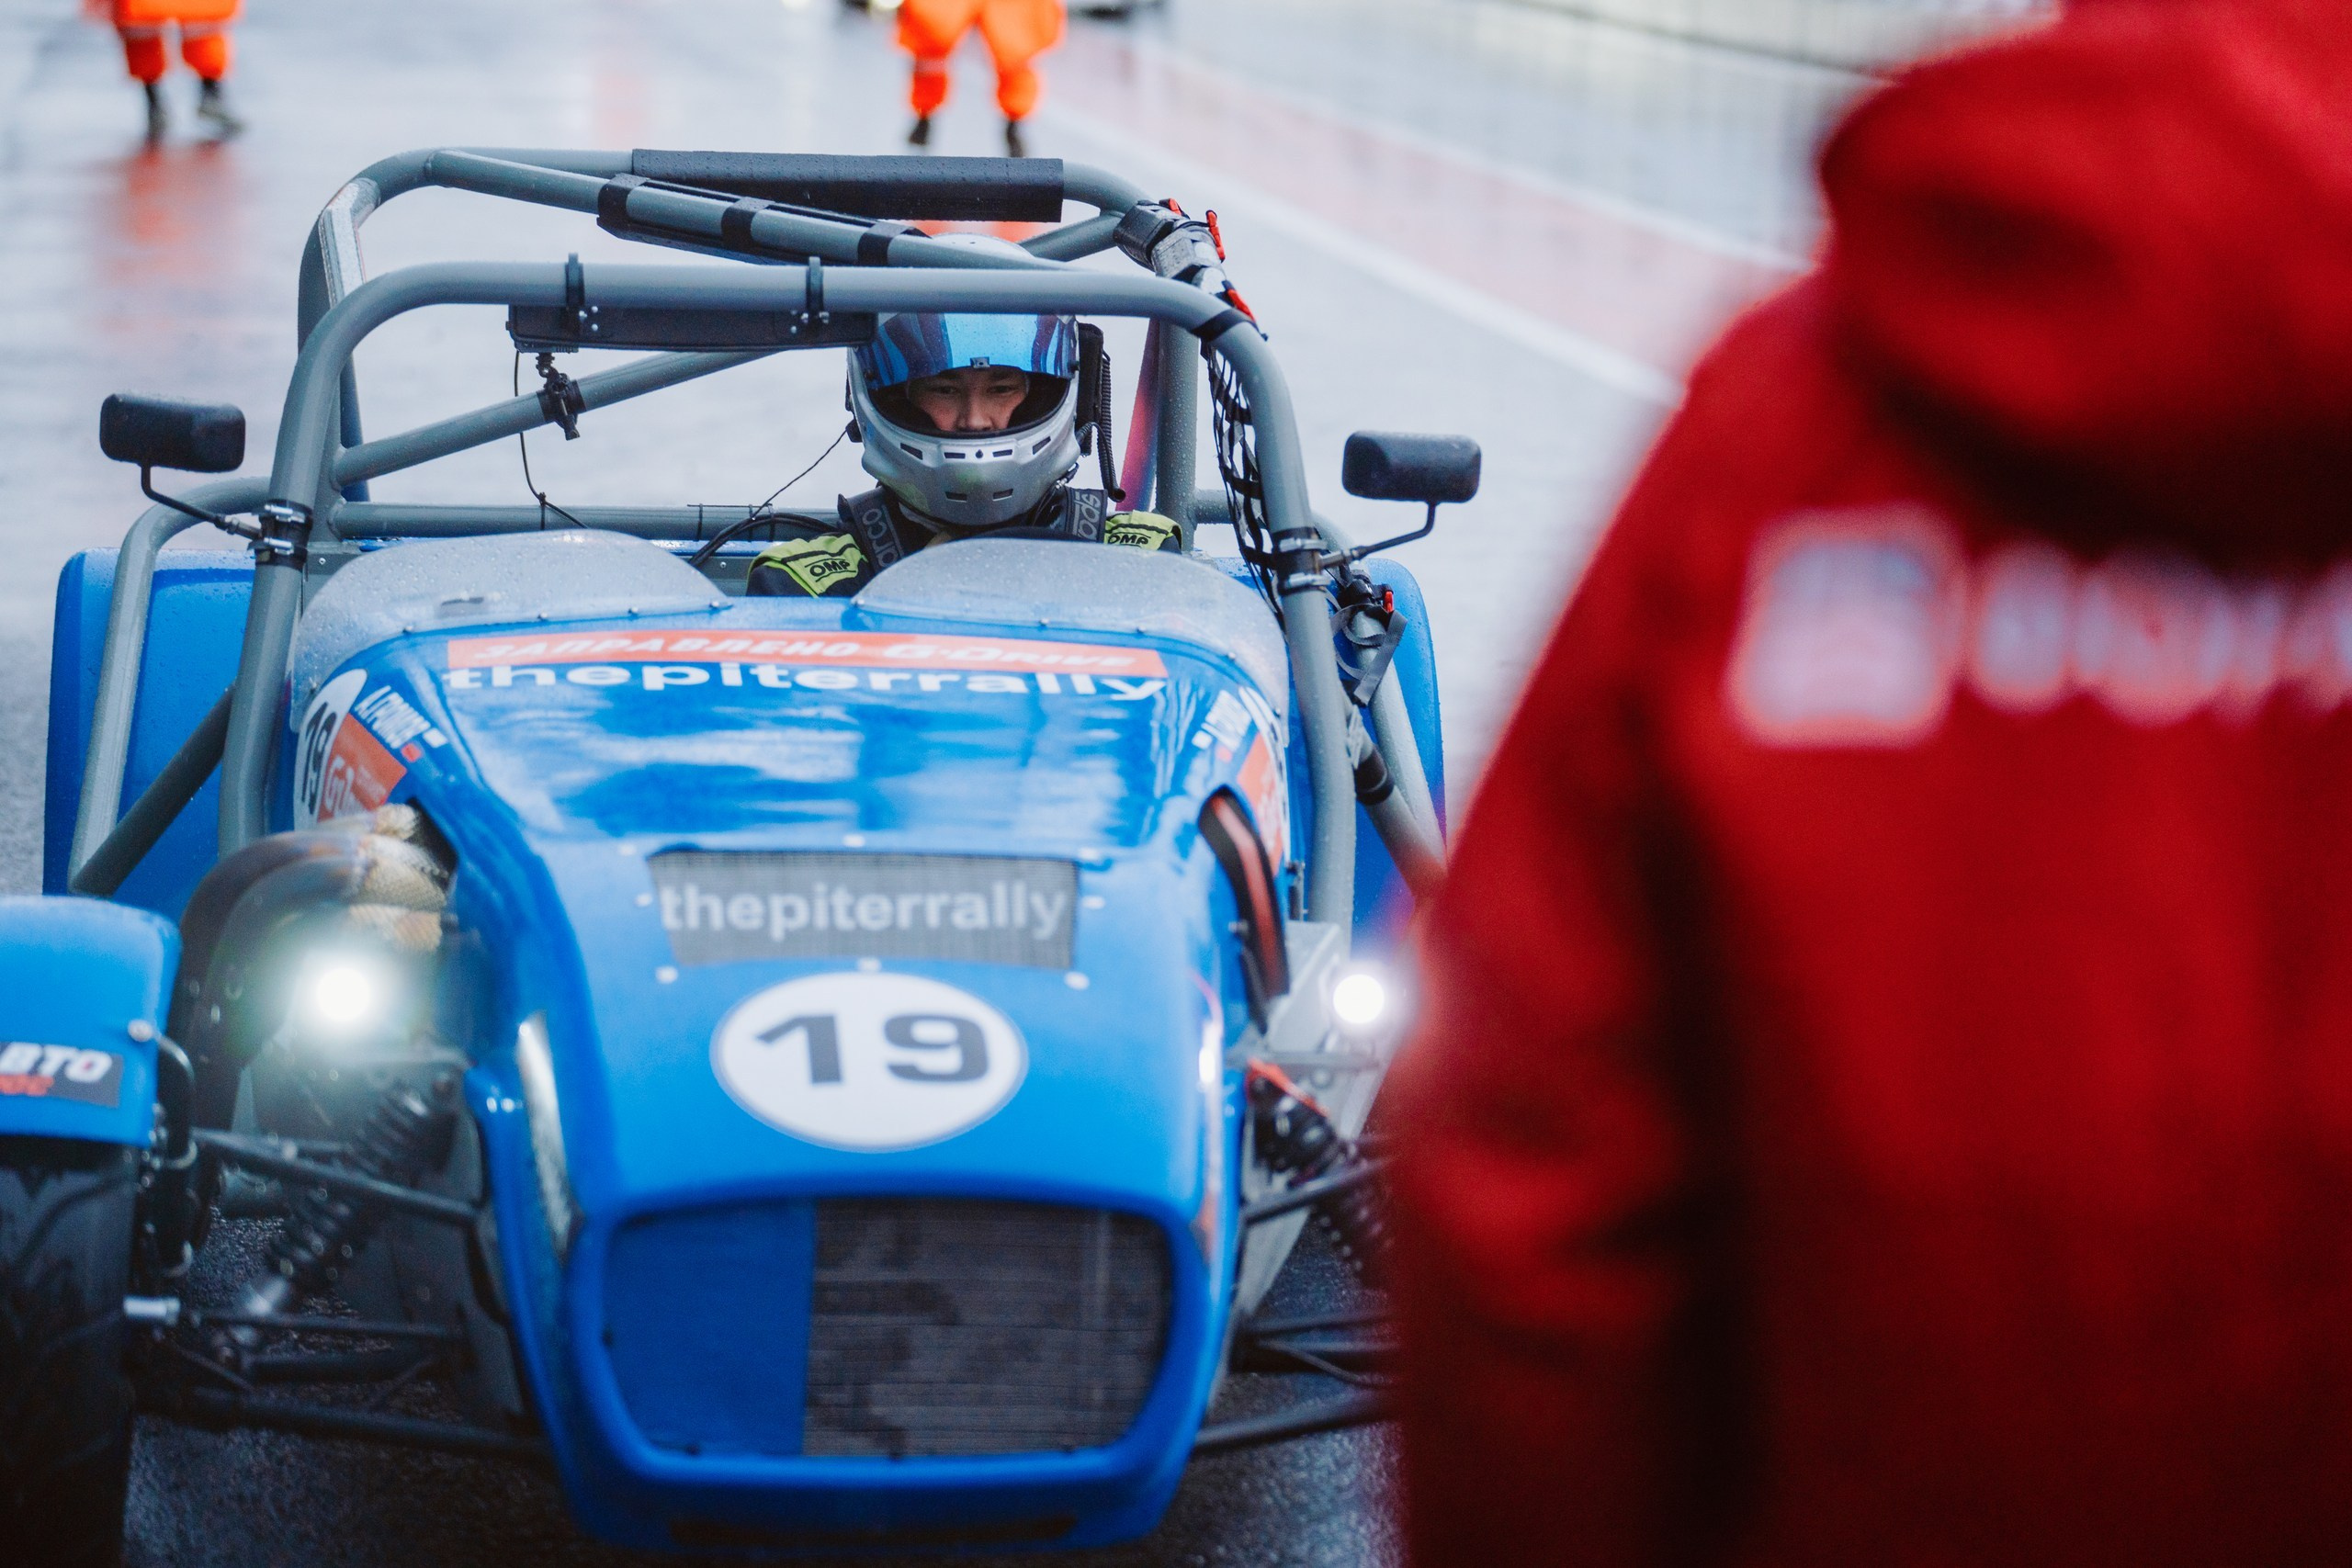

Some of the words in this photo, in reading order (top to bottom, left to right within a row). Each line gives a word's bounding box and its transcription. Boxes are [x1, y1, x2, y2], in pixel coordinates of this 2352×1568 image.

[1107, 534, 1149, 545] OMP
[809, 559, 851, 577] OMP
[474, 637, 861, 660] ЗАПРАВЛЕНО
[442, 662, 1168, 701] thepiterrally
[301, 702, 337, 816] 19
[659, 880, 1068, 942] thepiterrally
[754, 1013, 990, 1085] 19
